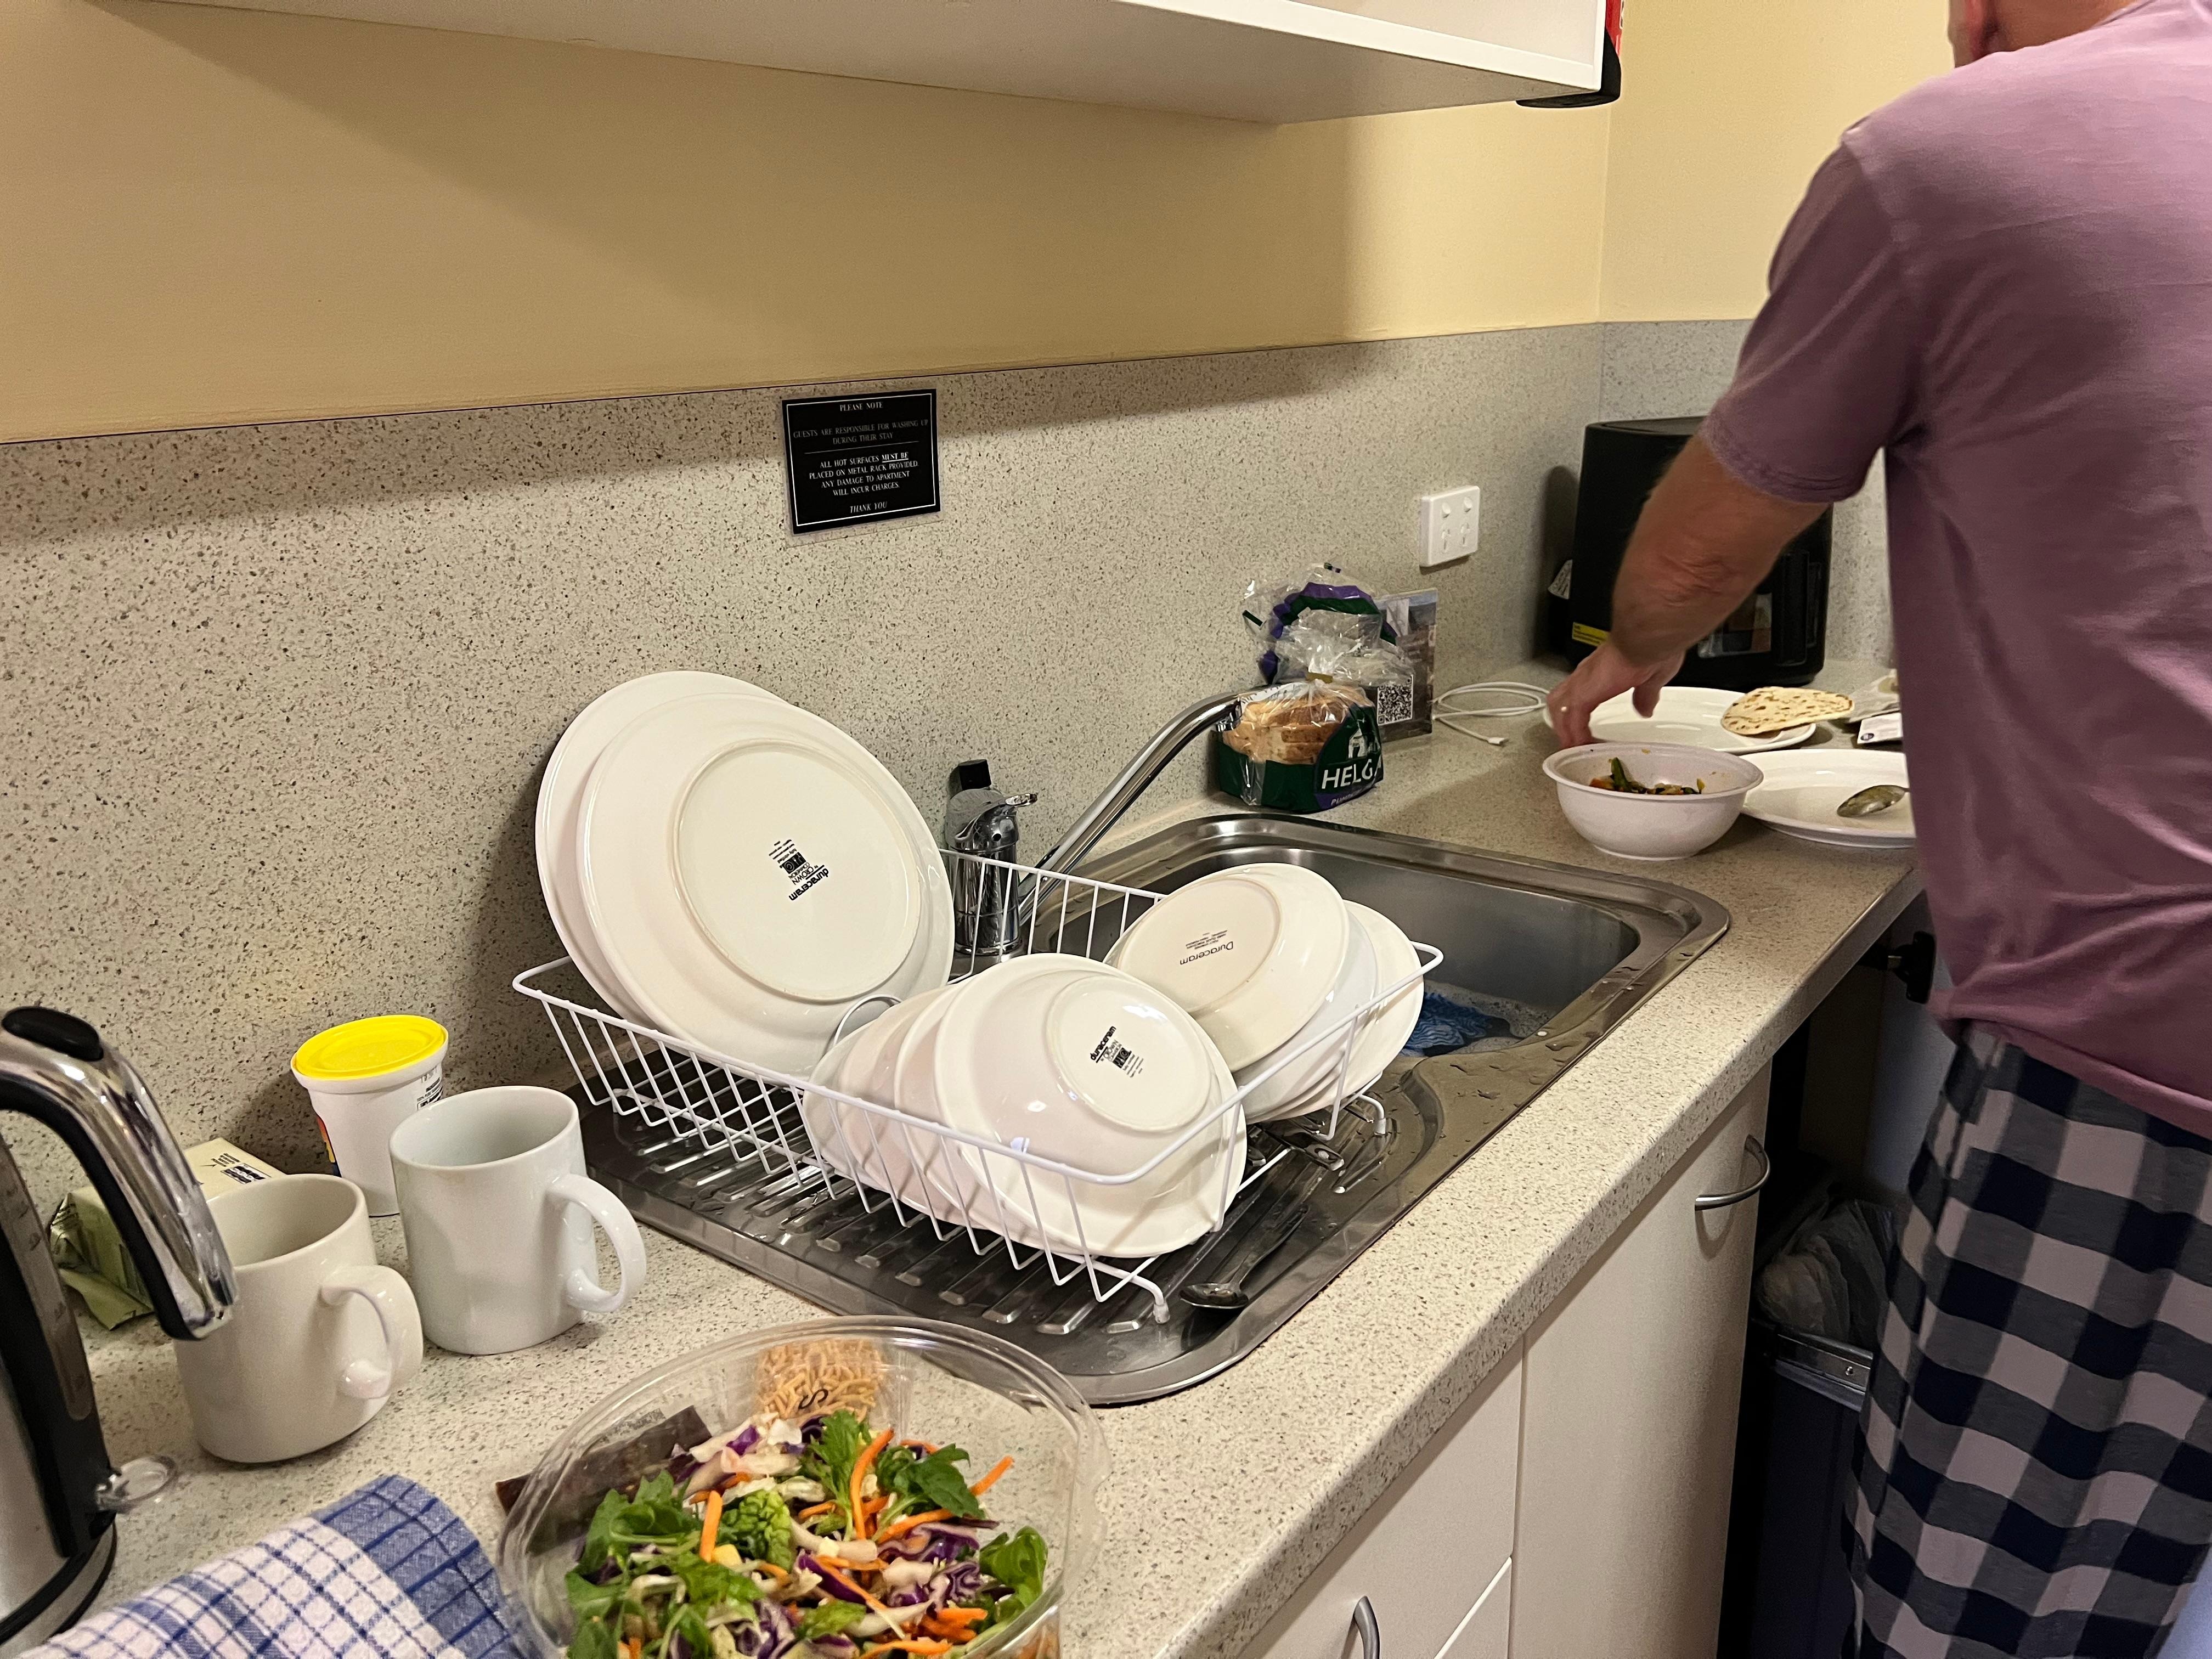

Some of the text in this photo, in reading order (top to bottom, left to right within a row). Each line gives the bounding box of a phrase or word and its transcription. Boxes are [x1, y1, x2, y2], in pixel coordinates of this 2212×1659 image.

[839, 403, 863, 411] PLEASE
[793, 430, 818, 438] GUESTS
[836, 424, 875, 434] RESPONSIBLE
[833, 436, 857, 444] DURING
[834, 459, 847, 467] HOT
[849, 455, 879, 465] SURFACES
[882, 453, 898, 461] MUST
[809, 471, 834, 479] PLACED
[848, 466, 868, 475] METAL
[870, 464, 887, 472] RACK
[821, 480, 834, 488] ANY
[837, 477, 864, 486] DAMAGE
[876, 470, 910, 481] APARTMENT
[851, 486, 870, 494] INCUR
[850, 501, 888, 514] THANK YOU
[792, 866, 814, 885] CROWN
[788, 868, 829, 900] duraceram
[1180, 941, 1233, 965] Duraceram
[1090, 1026, 1116, 1060] duraceram
